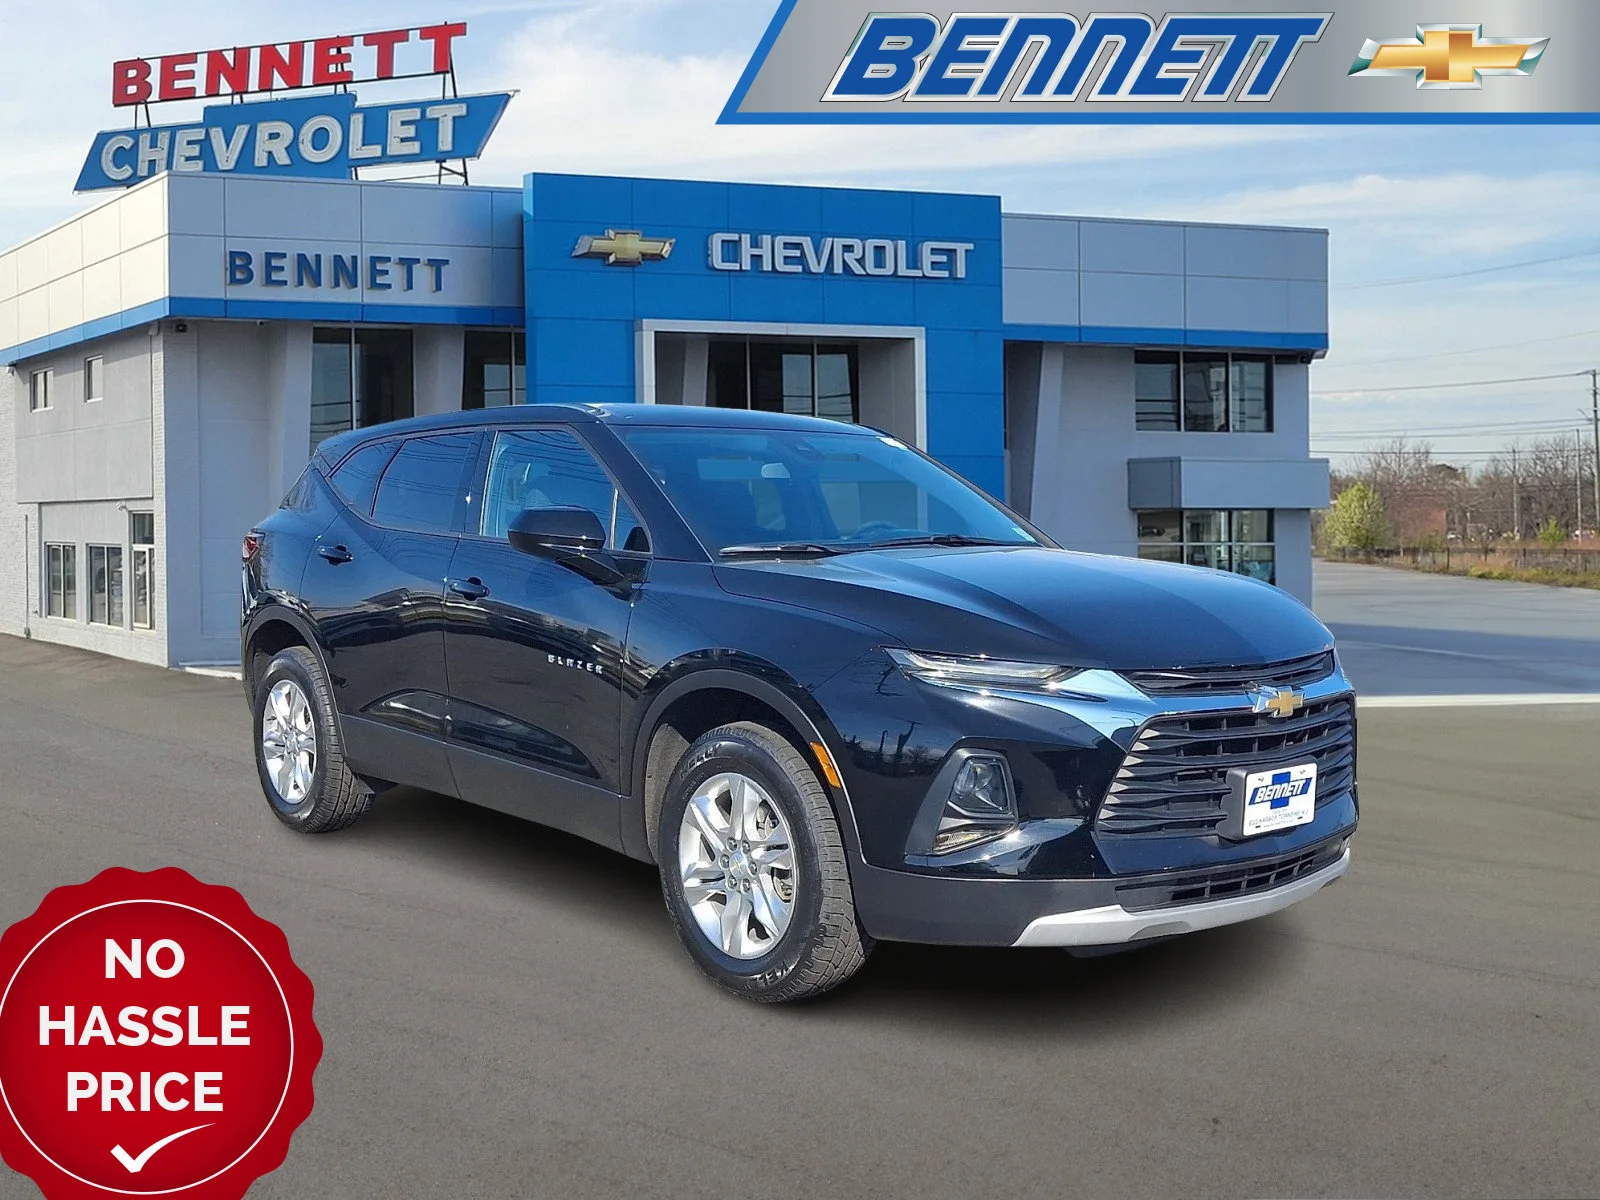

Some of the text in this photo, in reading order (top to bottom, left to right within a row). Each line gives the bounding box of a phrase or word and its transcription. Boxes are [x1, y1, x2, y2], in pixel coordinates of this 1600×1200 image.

[112, 22, 467, 106] BENNETT
[100, 103, 468, 181] CHEVROLET
[227, 249, 451, 293] BENNETT
[709, 232, 975, 279] CHEVROLET
[547, 654, 604, 675] BLAZER
[1254, 780, 1306, 804] BENNETT
